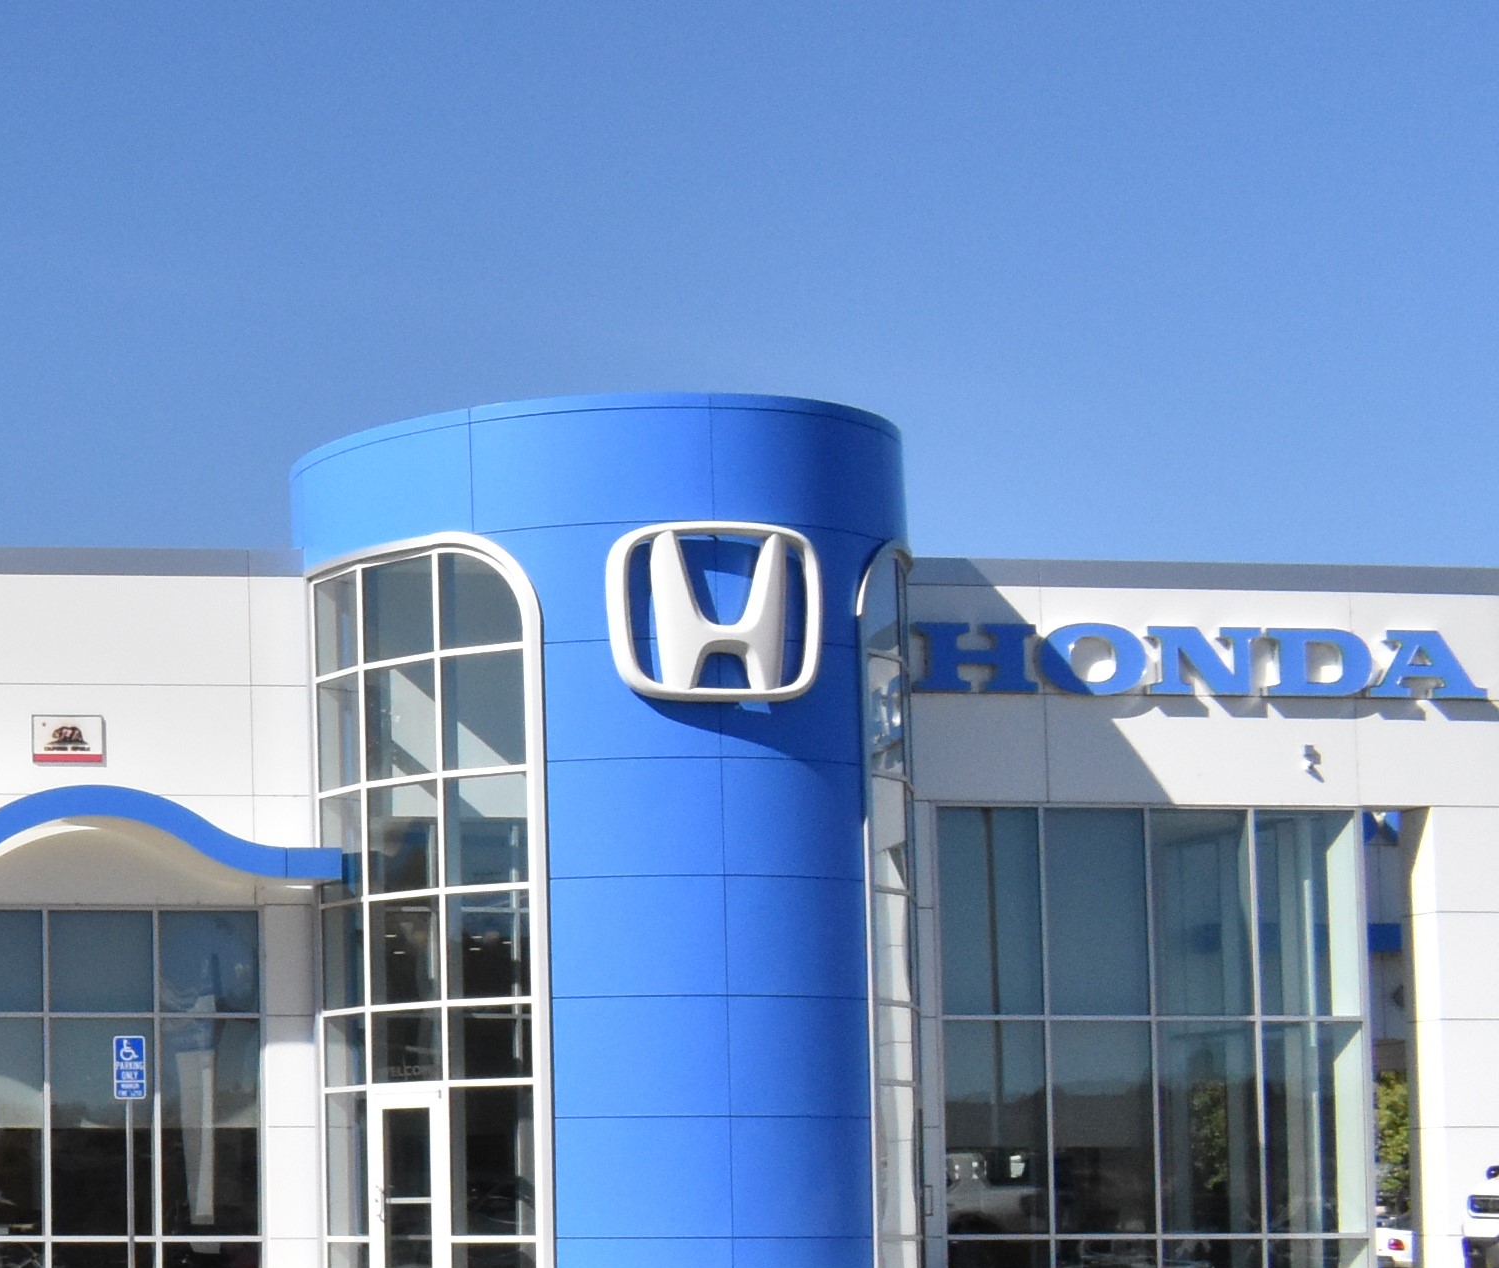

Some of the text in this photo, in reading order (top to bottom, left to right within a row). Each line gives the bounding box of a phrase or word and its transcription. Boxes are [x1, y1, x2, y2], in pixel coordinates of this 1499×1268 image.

[911, 621, 1487, 699] HONDA
[114, 1062, 144, 1071] PARKING
[121, 1071, 139, 1080] ONLY
